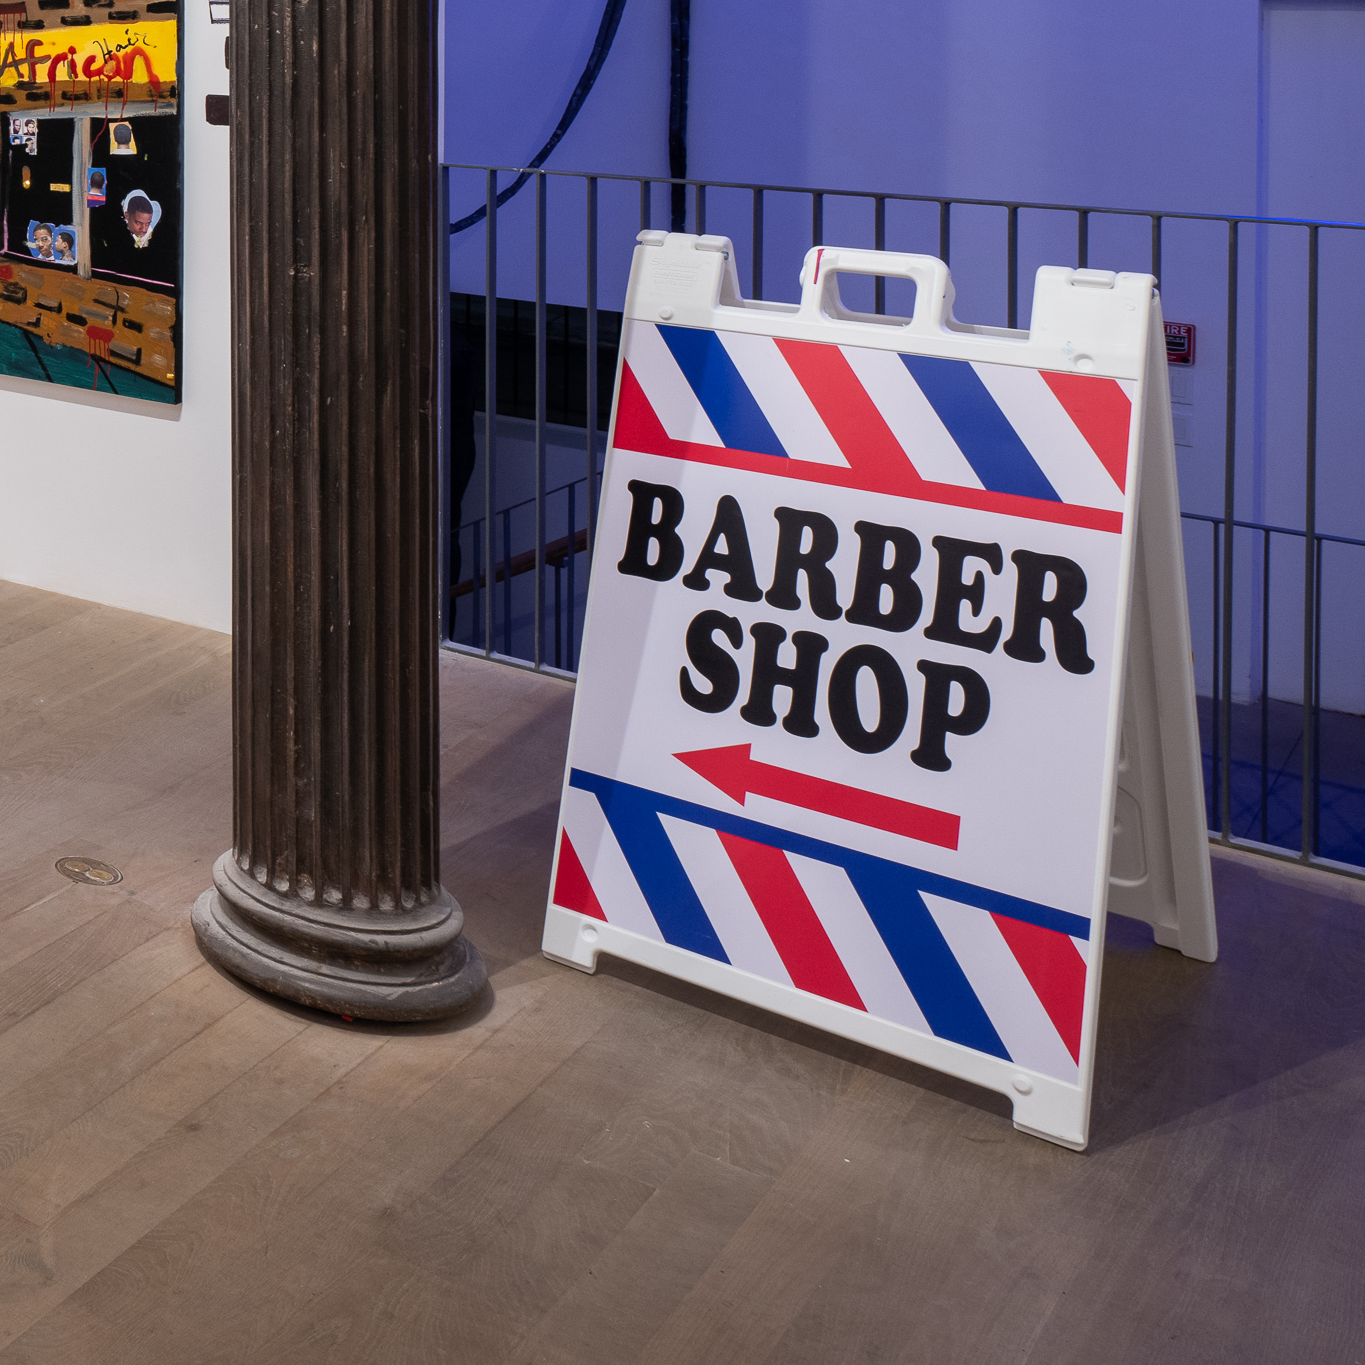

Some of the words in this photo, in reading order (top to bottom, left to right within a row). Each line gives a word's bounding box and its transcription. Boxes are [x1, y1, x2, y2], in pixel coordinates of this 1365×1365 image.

[1165, 324, 1189, 335] IRE
[617, 478, 1096, 676] BARBER
[678, 609, 991, 773] SHOP
